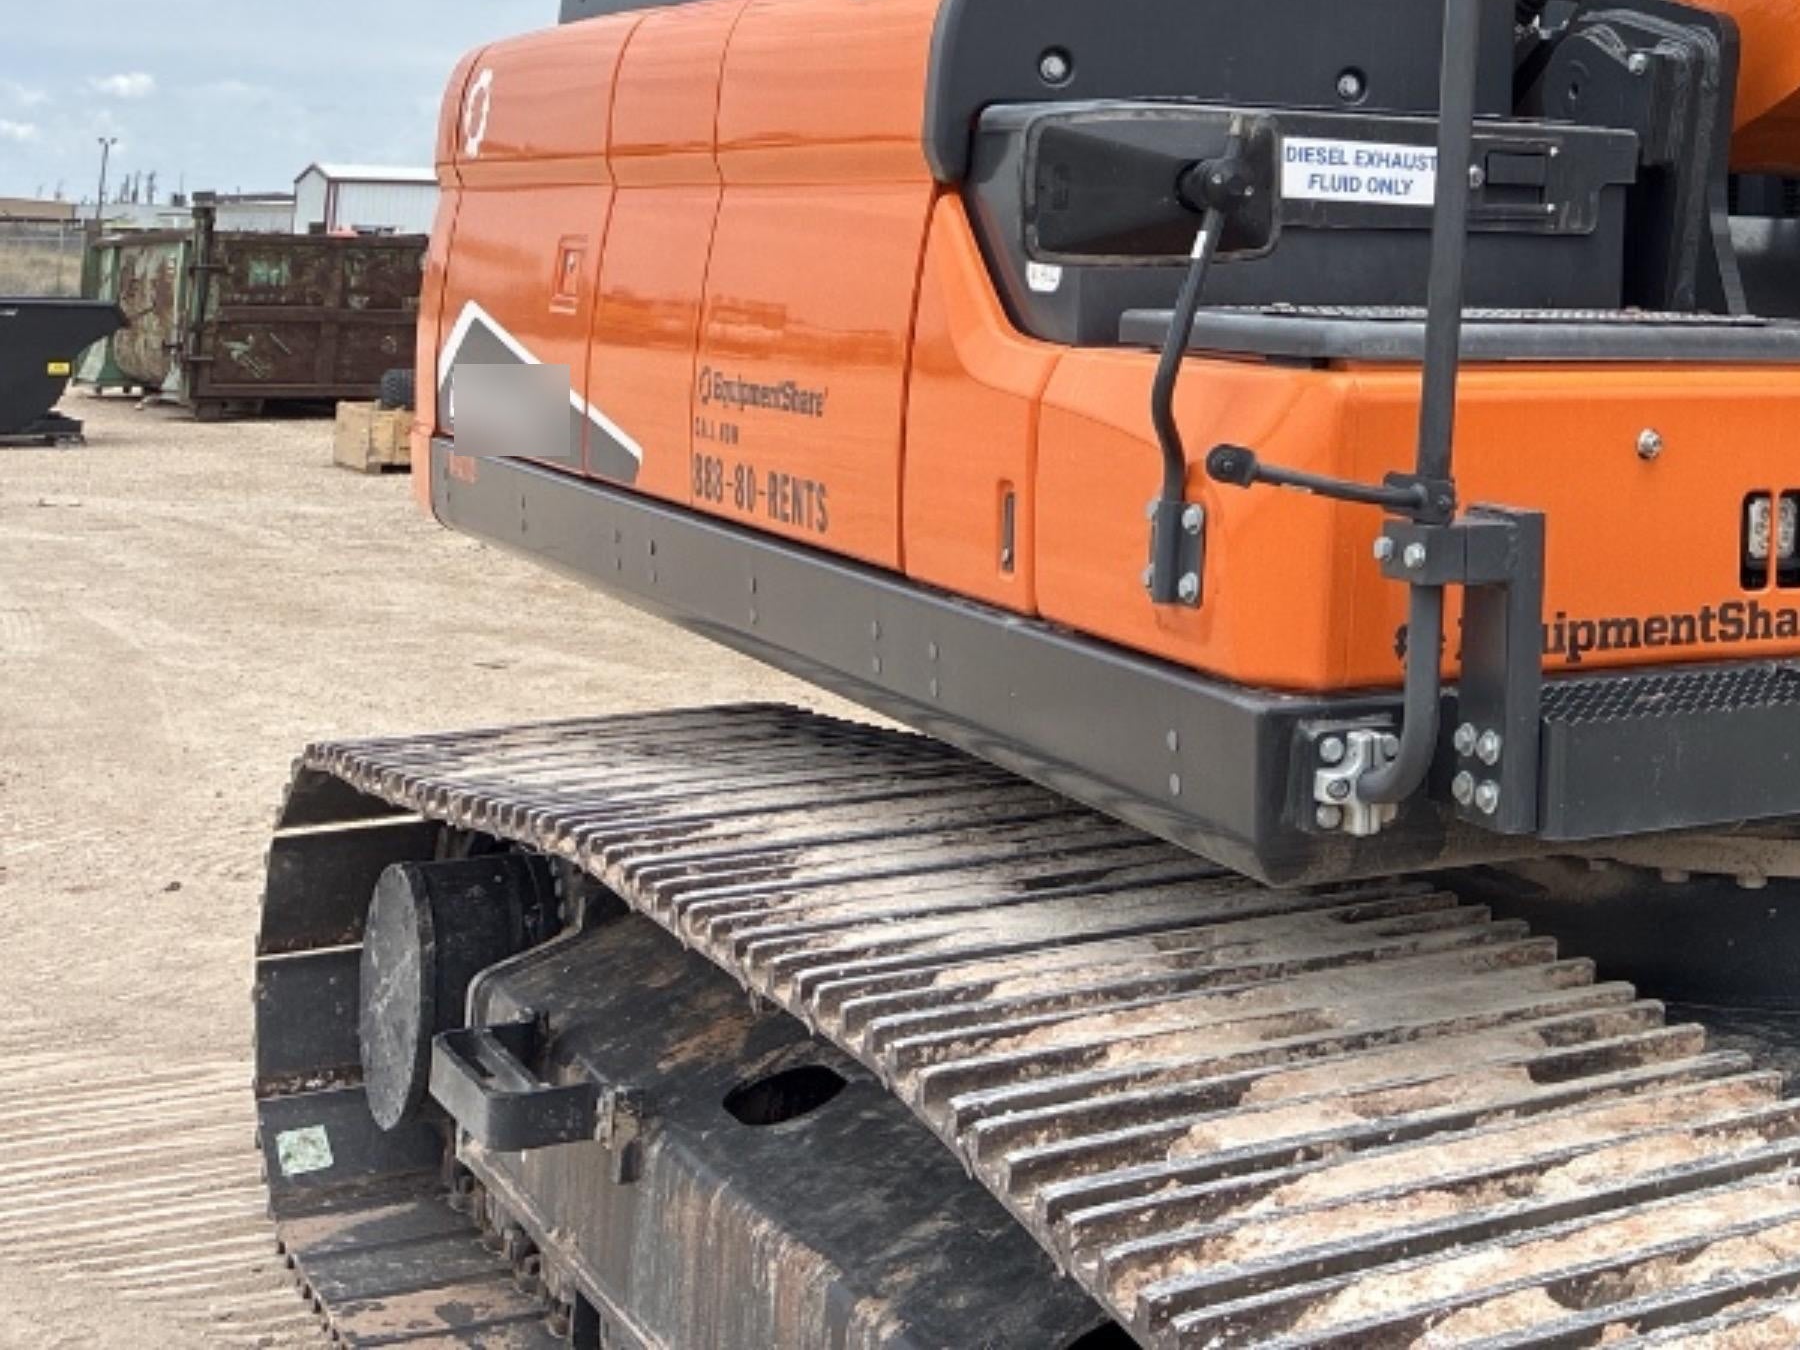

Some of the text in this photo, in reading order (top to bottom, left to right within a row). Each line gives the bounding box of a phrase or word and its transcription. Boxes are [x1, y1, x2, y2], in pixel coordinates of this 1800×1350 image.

[1286, 145, 1437, 172] DIESEL EXHAUST
[1307, 173, 1414, 196] FLUID ONLY
